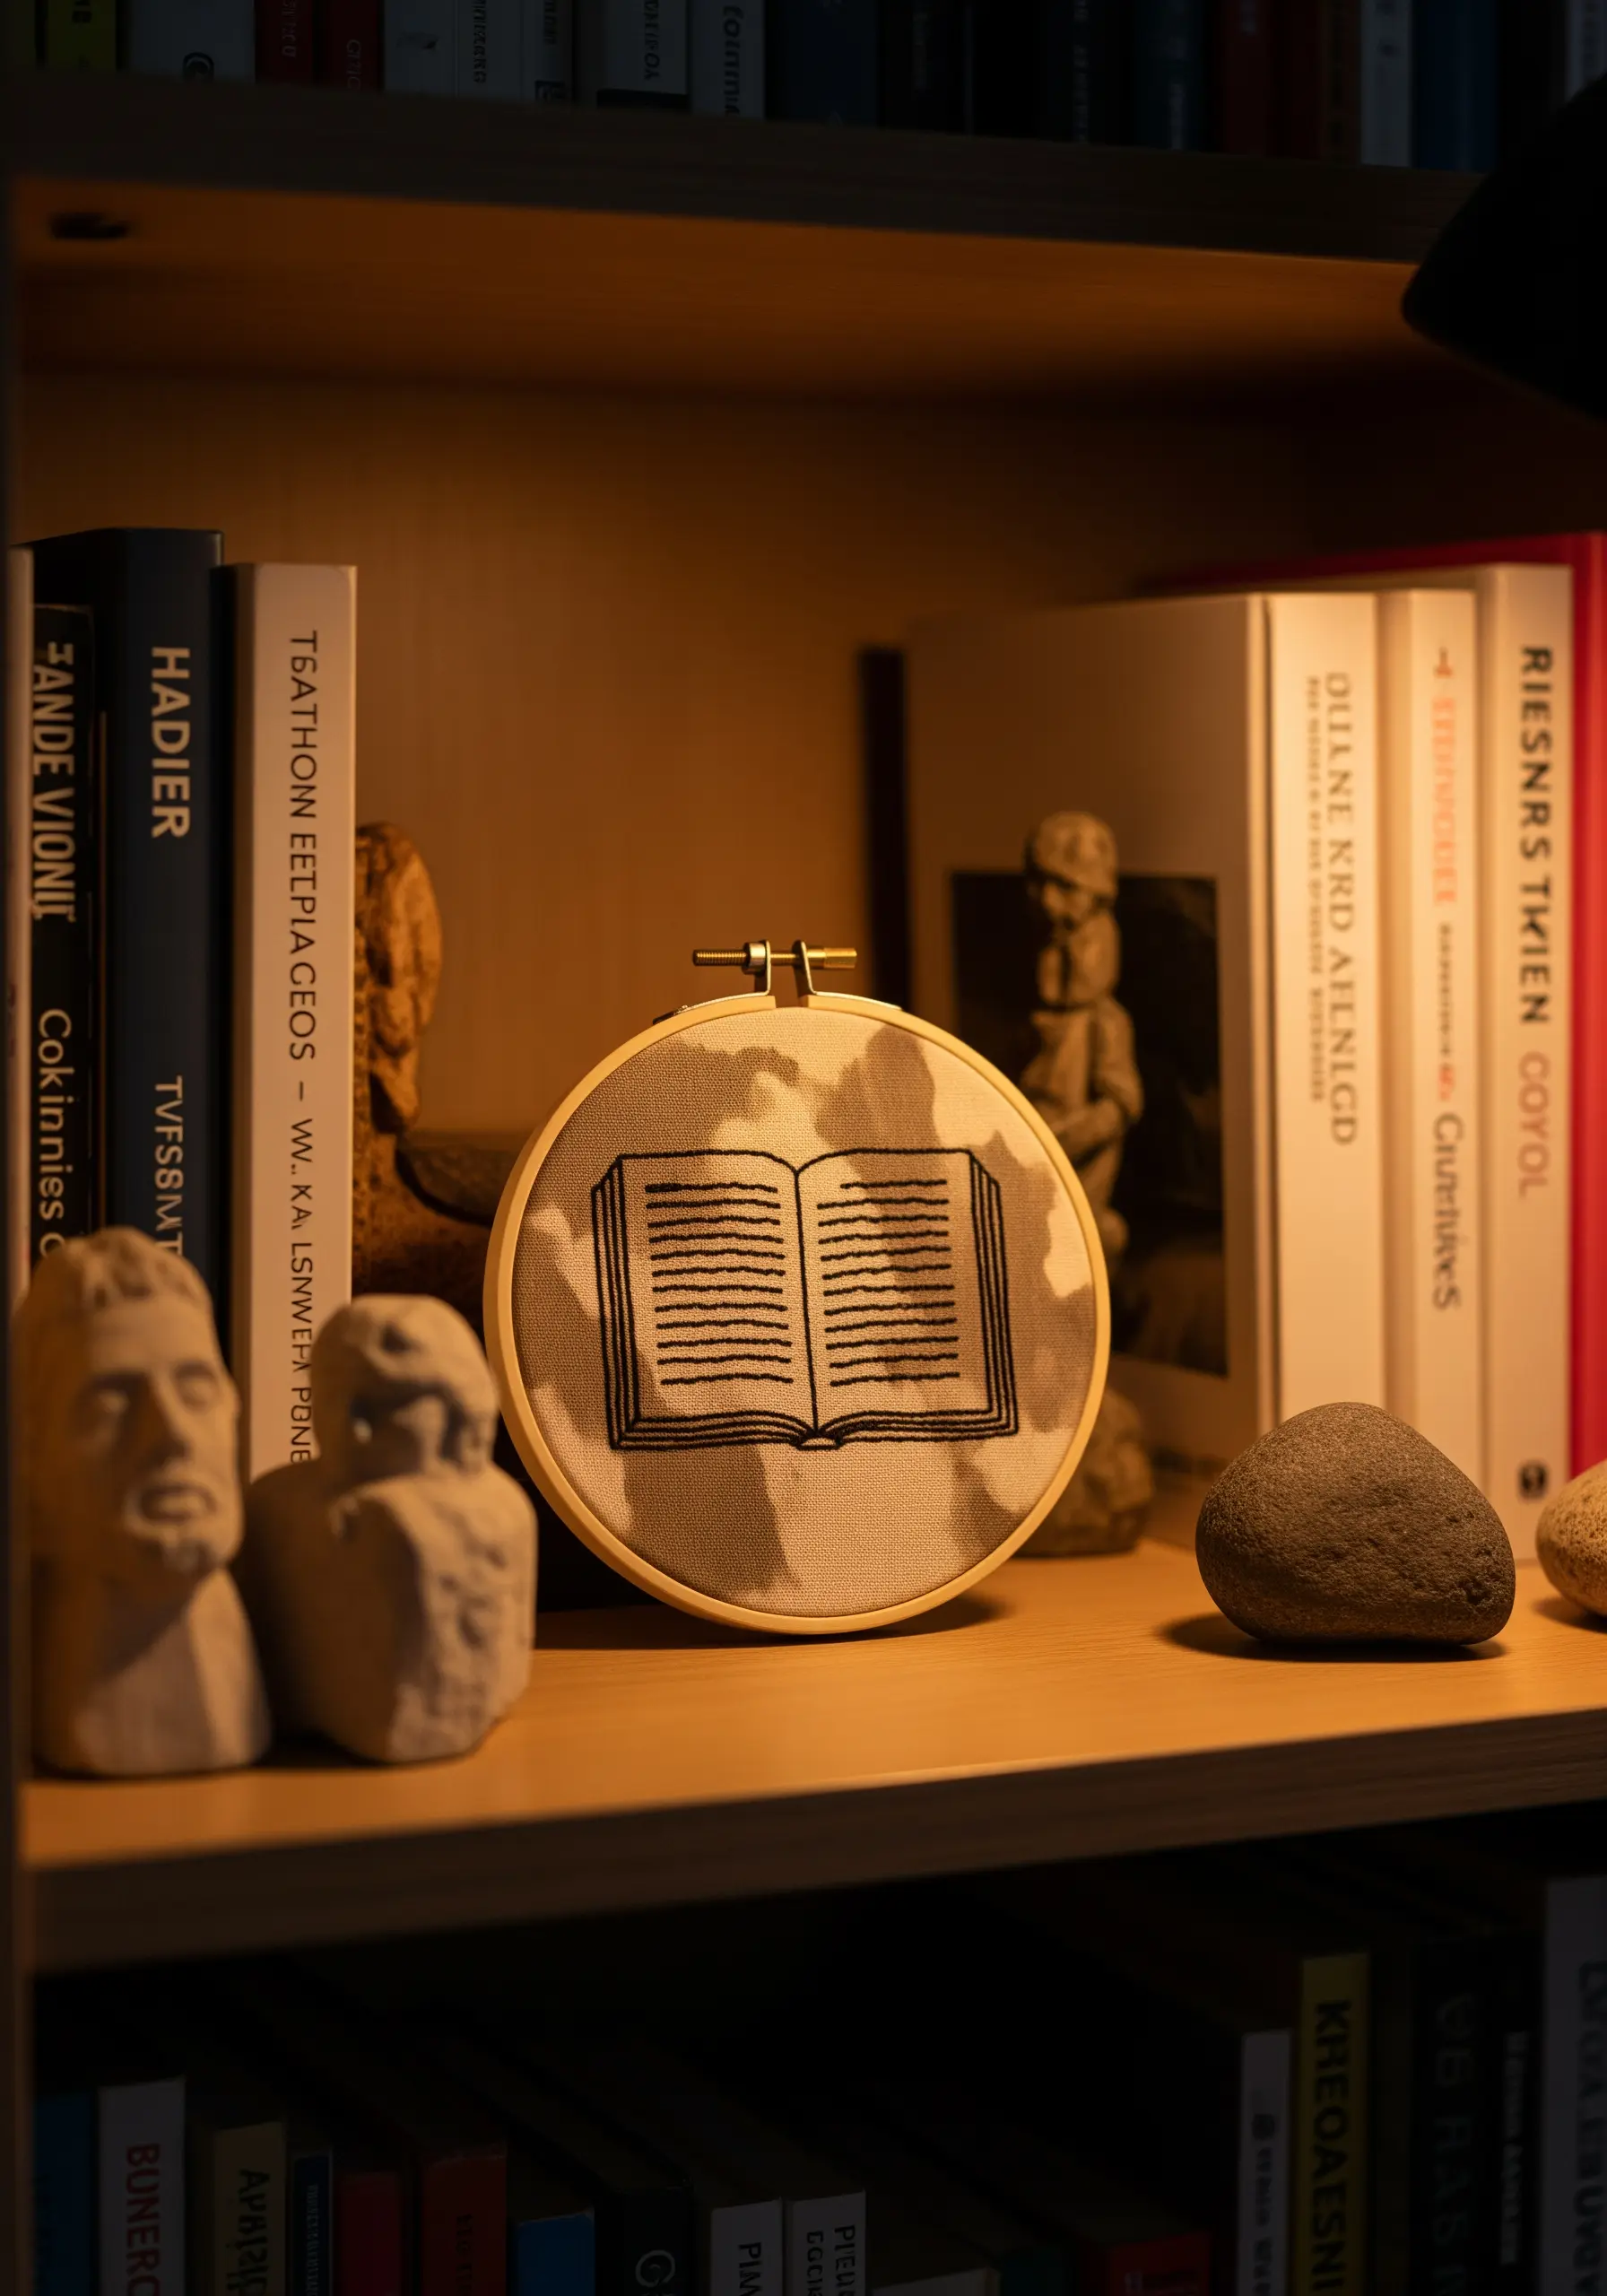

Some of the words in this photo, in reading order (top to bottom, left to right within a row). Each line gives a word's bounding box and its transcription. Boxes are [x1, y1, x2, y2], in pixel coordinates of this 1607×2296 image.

[151, 647, 191, 839] HADIER
[1521, 645, 1554, 861] RIESNRS
[1517, 1049, 1551, 1198] COYOL
